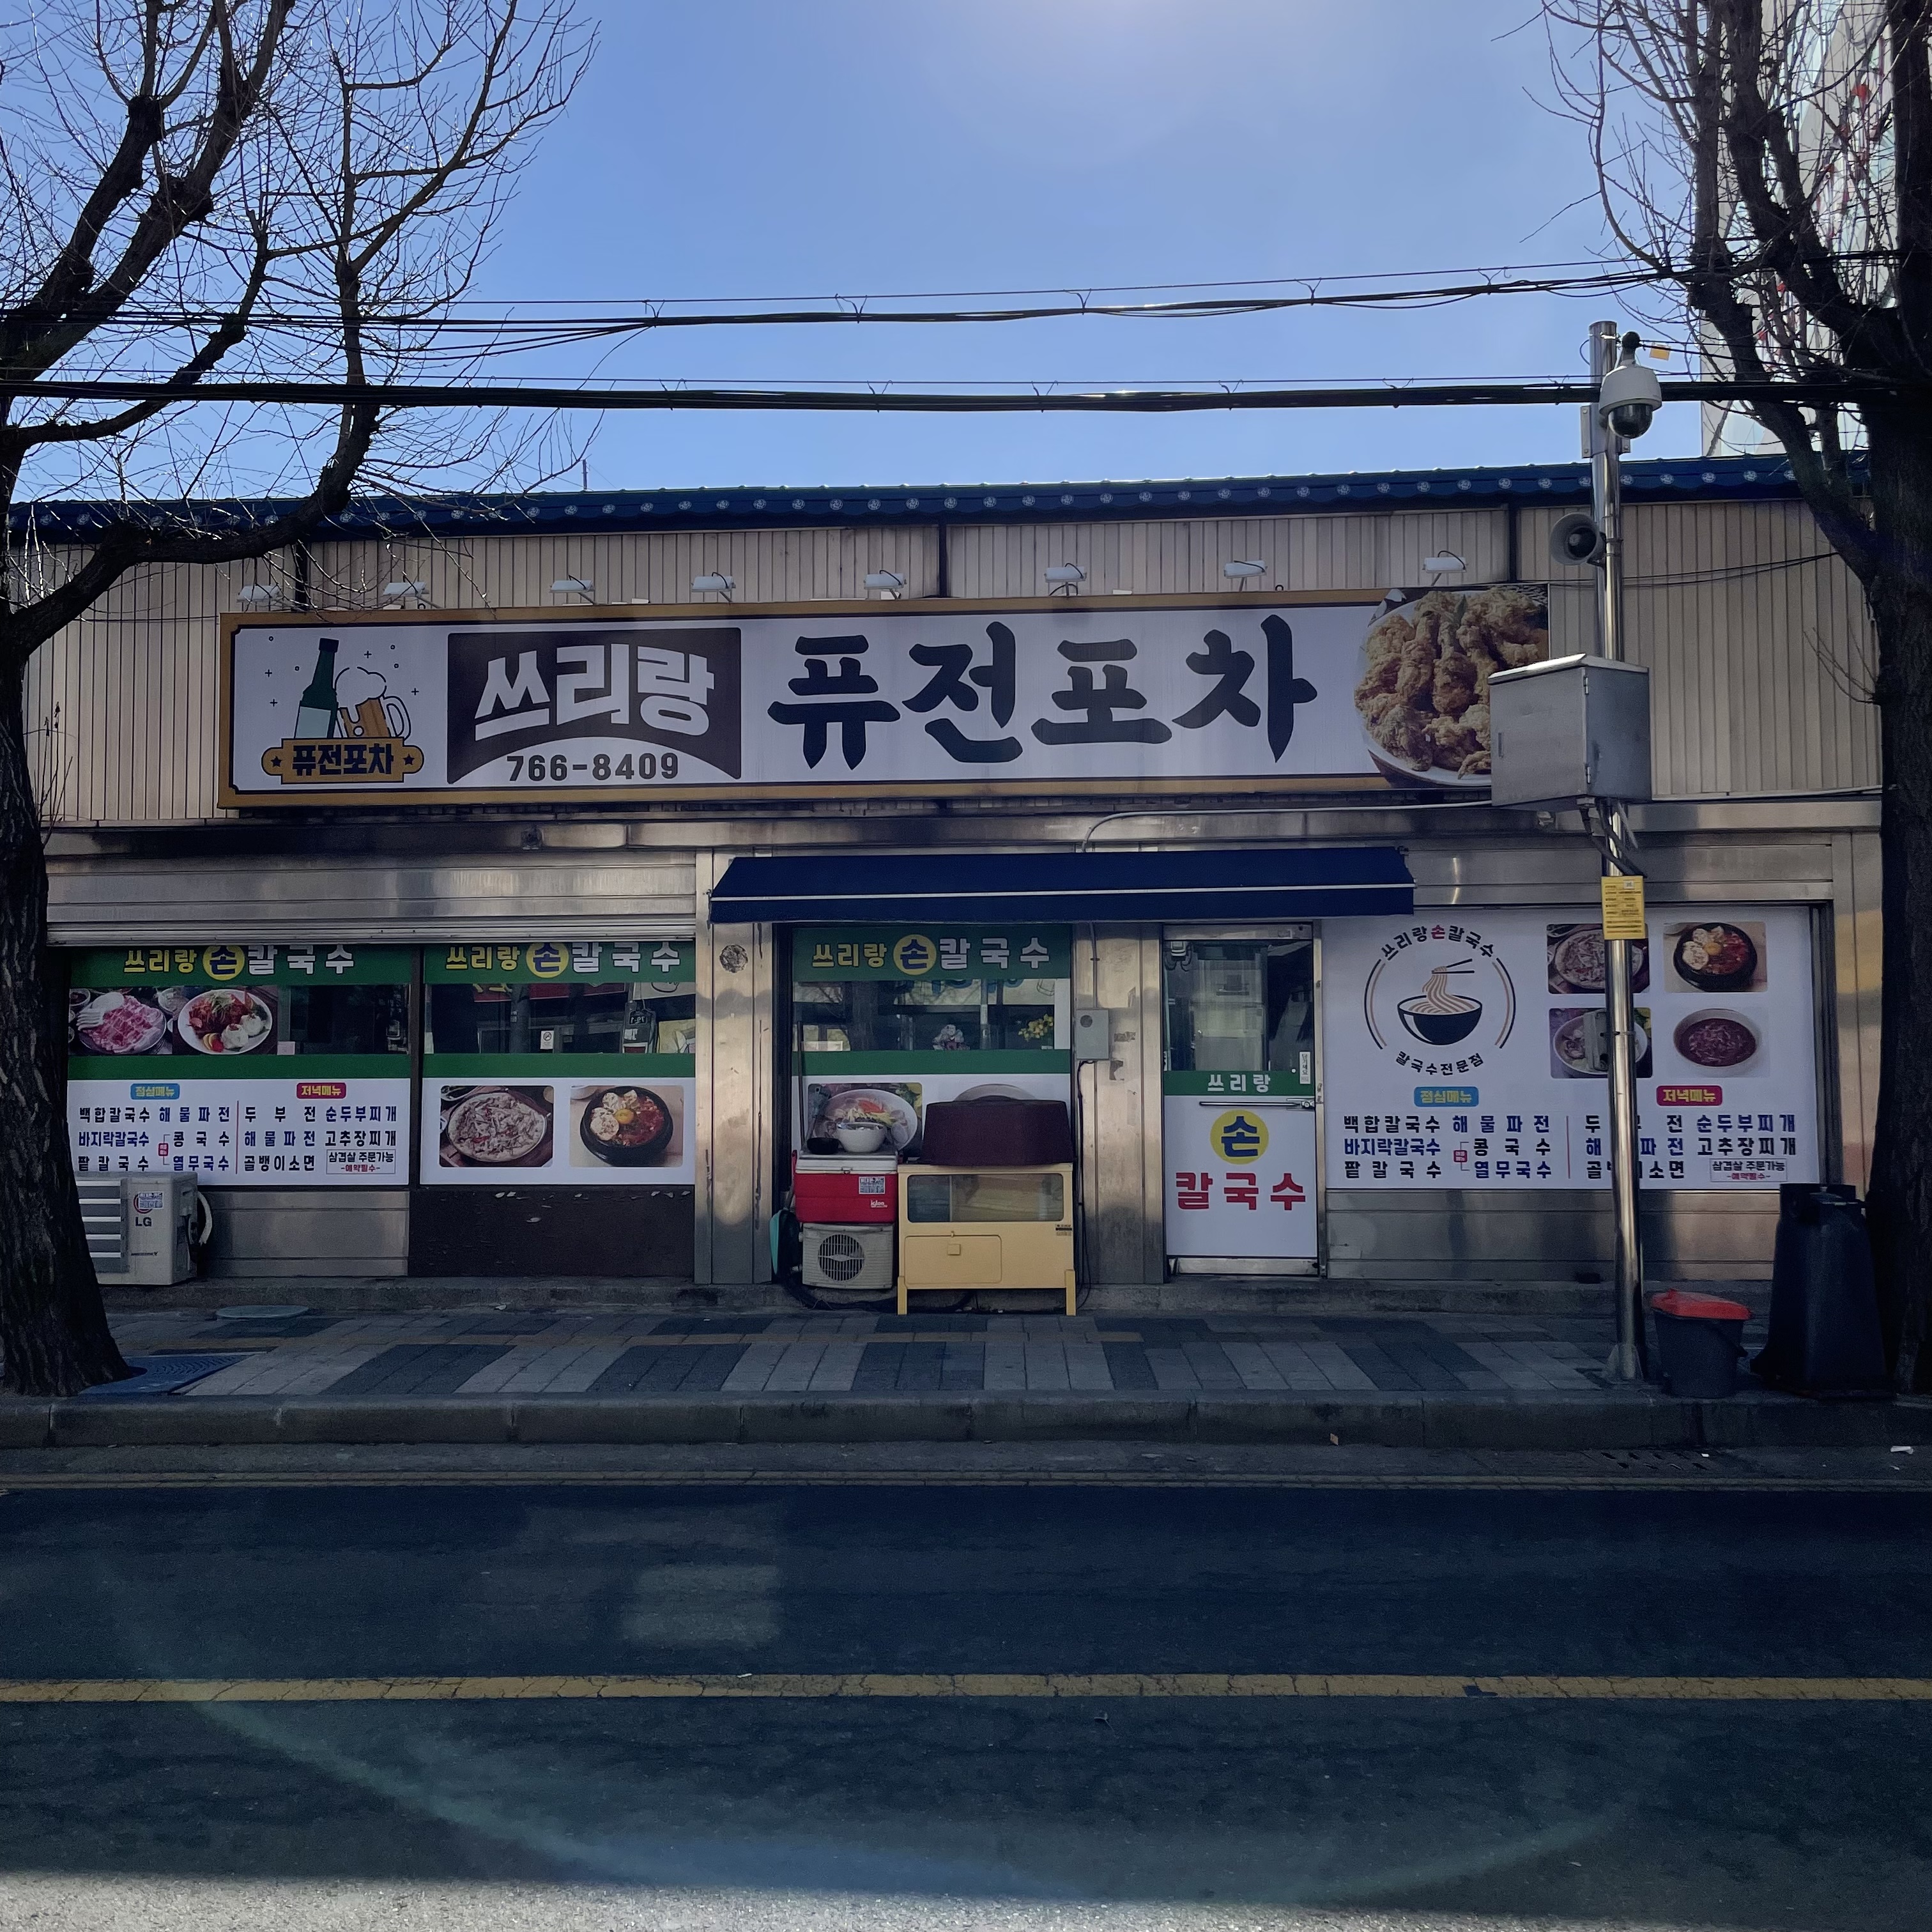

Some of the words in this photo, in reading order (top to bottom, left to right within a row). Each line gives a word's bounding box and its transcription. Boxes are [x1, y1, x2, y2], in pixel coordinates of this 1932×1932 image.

[475, 643, 715, 742] 쓰리랑
[767, 614, 1318, 770] 퓨전포차
[292, 742, 394, 776] 퓨전포차
[508, 753, 679, 782] 766-8409
[124, 949, 197, 974] 쓰리랑
[446, 946, 521, 970] 쓰리랑
[811, 942, 887, 968] 쓰리랑
[1395, 1050, 1483, 1076] 칼국수전문점
[135, 1086, 175, 1097] 점심메뉴
[301, 1085, 342, 1096] 저녁메뉴
[1207, 1074, 1271, 1093] 쓰리랑
[1420, 1090, 1473, 1104] 점심메뉴
[1662, 1088, 1716, 1103] 저녁메뉴
[79, 1107, 150, 1123] 백합칼국수
[325, 1106, 397, 1123] 순두부찌개
[1696, 1114, 1795, 1133] 순두부찌개
[1344, 1116, 1440, 1133] 백합칼국수
[79, 1131, 150, 1147] 바지락칼국수
[325, 1130, 396, 1147] 고추장찌개
[1221, 1116, 1261, 1158] 손
[1344, 1138, 1441, 1156] 바지락칼국수
[1697, 1137, 1796, 1156] 고추장찌개
[173, 1155, 229, 1171] 열무국수
[244, 1155, 315, 1172] 골뱅이소면
[329, 1151, 356, 1163] 삼겹살
[359, 1151, 394, 1163] 주문가능
[1712, 1161, 1744, 1172] 삼겹살
[1745, 1160, 1785, 1172] 주문가능
[1475, 1161, 1551, 1179] 열무국수
[1176, 1171, 1307, 1211] 칼국수
[135, 1216, 152, 1227] LG
